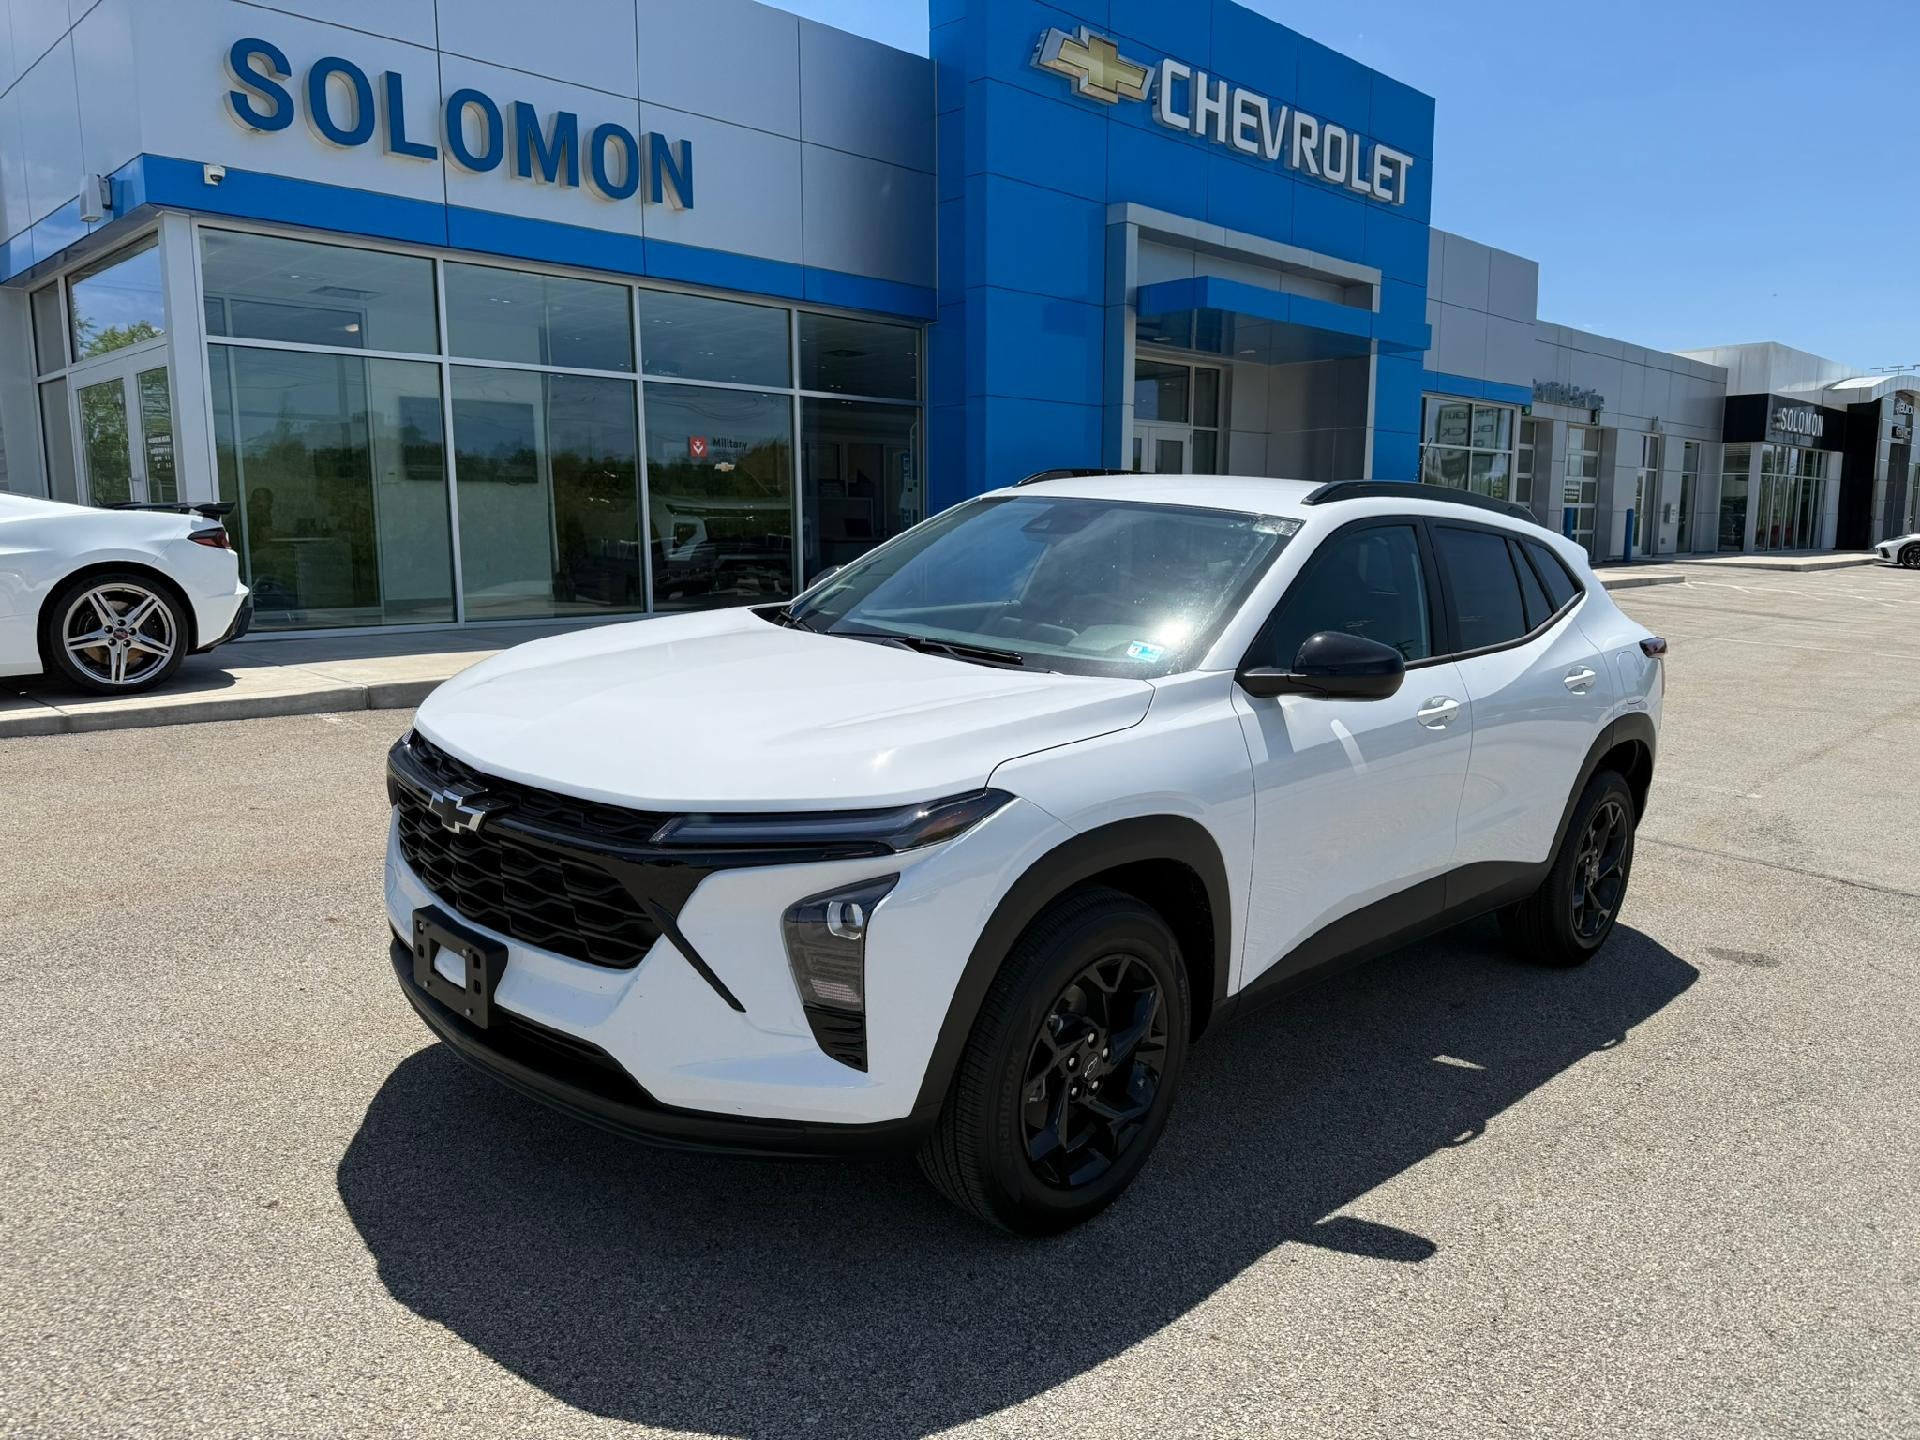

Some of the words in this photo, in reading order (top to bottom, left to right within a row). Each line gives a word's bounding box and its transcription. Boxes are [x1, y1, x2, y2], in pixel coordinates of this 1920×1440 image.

[224, 37, 695, 211] SOLOMON
[1153, 57, 1414, 205] CHEVROLET
[712, 437, 748, 451] Military
[1780, 406, 1824, 437] SOLOMON
